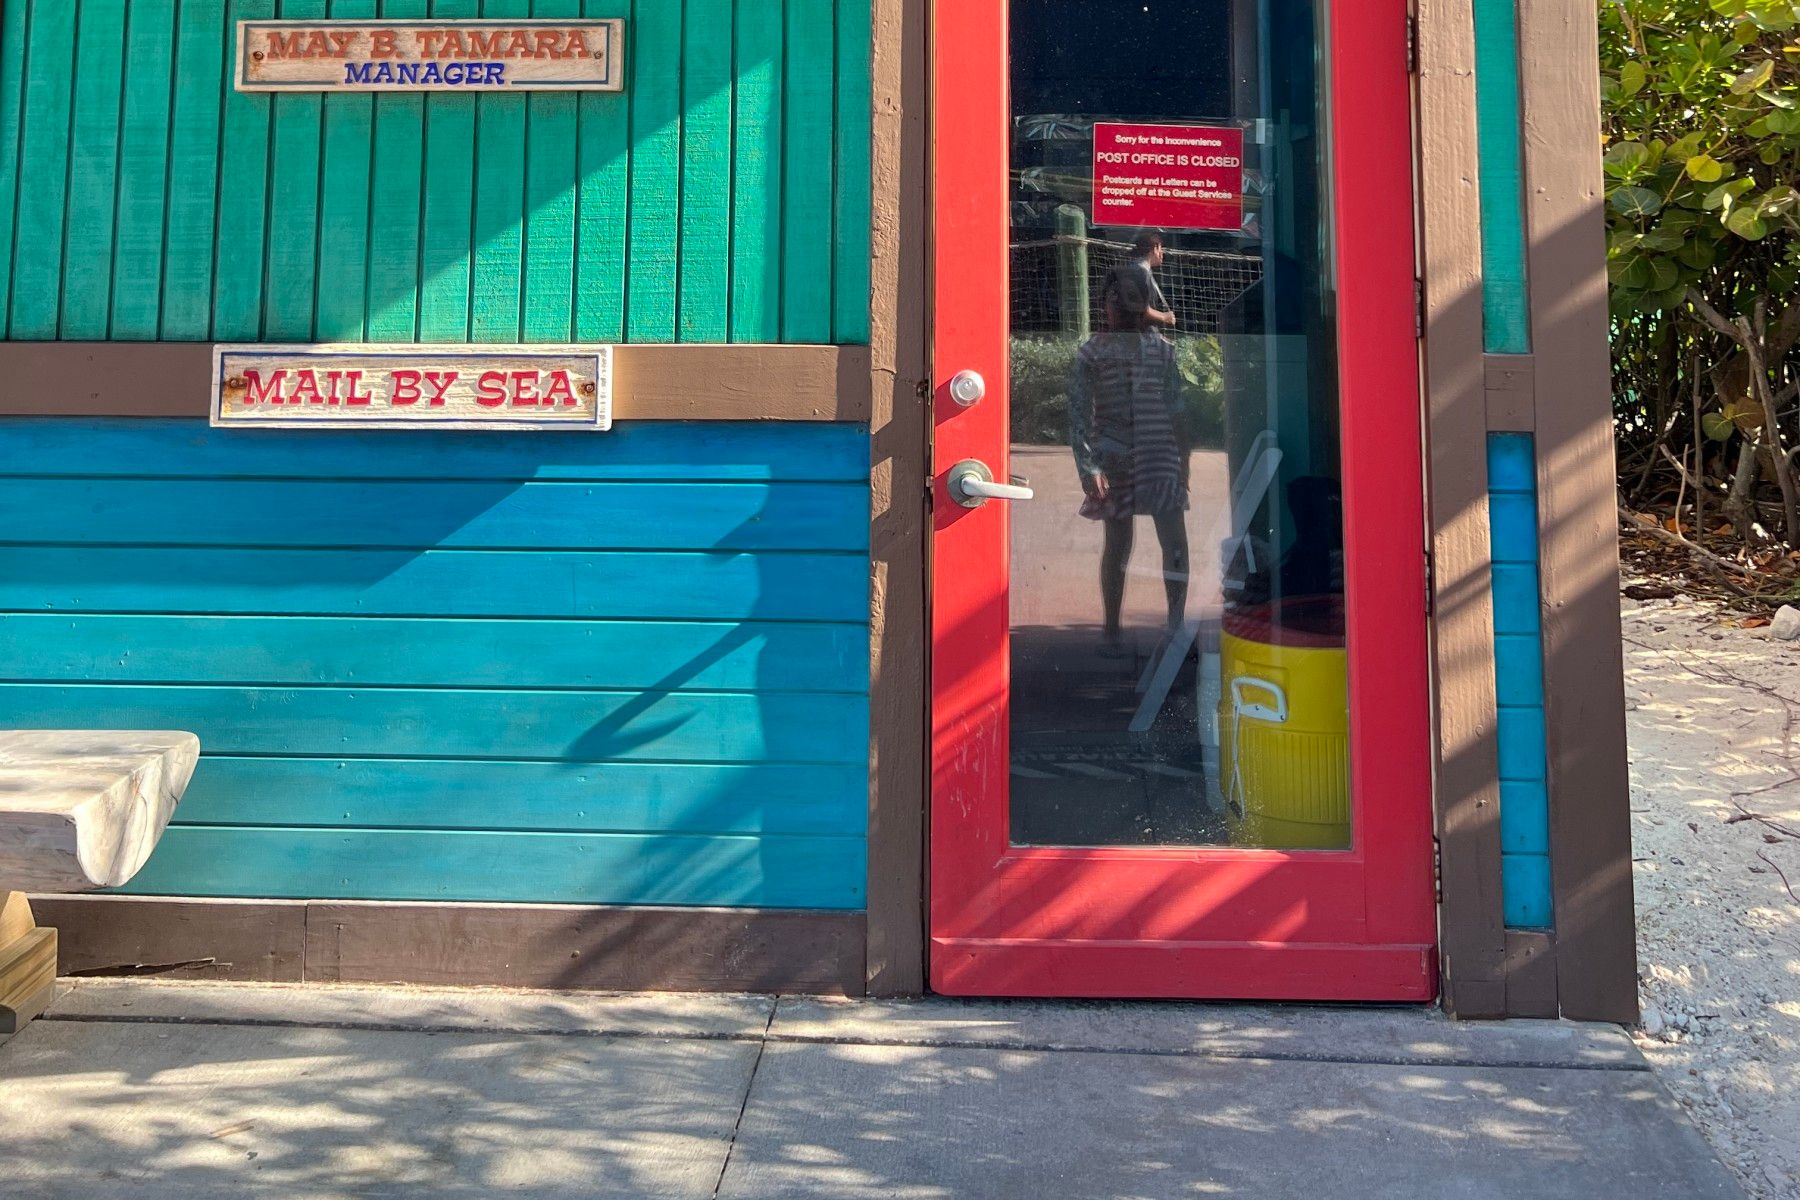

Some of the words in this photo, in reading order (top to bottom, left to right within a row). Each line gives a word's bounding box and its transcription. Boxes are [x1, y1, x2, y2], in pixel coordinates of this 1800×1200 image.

[266, 30, 357, 60] MAY
[369, 30, 404, 60] B.
[415, 30, 590, 60] TAMARA
[344, 62, 505, 85] MANAGER
[1115, 134, 1137, 145] Sorry
[1138, 135, 1149, 144] for
[1150, 136, 1164, 145] the
[1097, 152, 1129, 164] POST
[1131, 153, 1174, 165] OFFICE
[1177, 155, 1188, 166] IS
[1191, 155, 1240, 168] CLOSED
[1103, 175, 1142, 185] Postcards
[1143, 177, 1159, 186] and
[1161, 177, 1188, 187] Letters
[1206, 179, 1217, 188] be
[1102, 186, 1134, 196] dropped
[1135, 187, 1147, 196] off
[1147, 188, 1157, 196] at
[1157, 188, 1171, 197] the
[1172, 189, 1197, 198] Guest
[1197, 189, 1232, 199] Services
[1102, 198, 1134, 207] counter.
[243, 370, 373, 406] MAIL
[390, 370, 459, 406] BY
[475, 370, 577, 408] SEA
